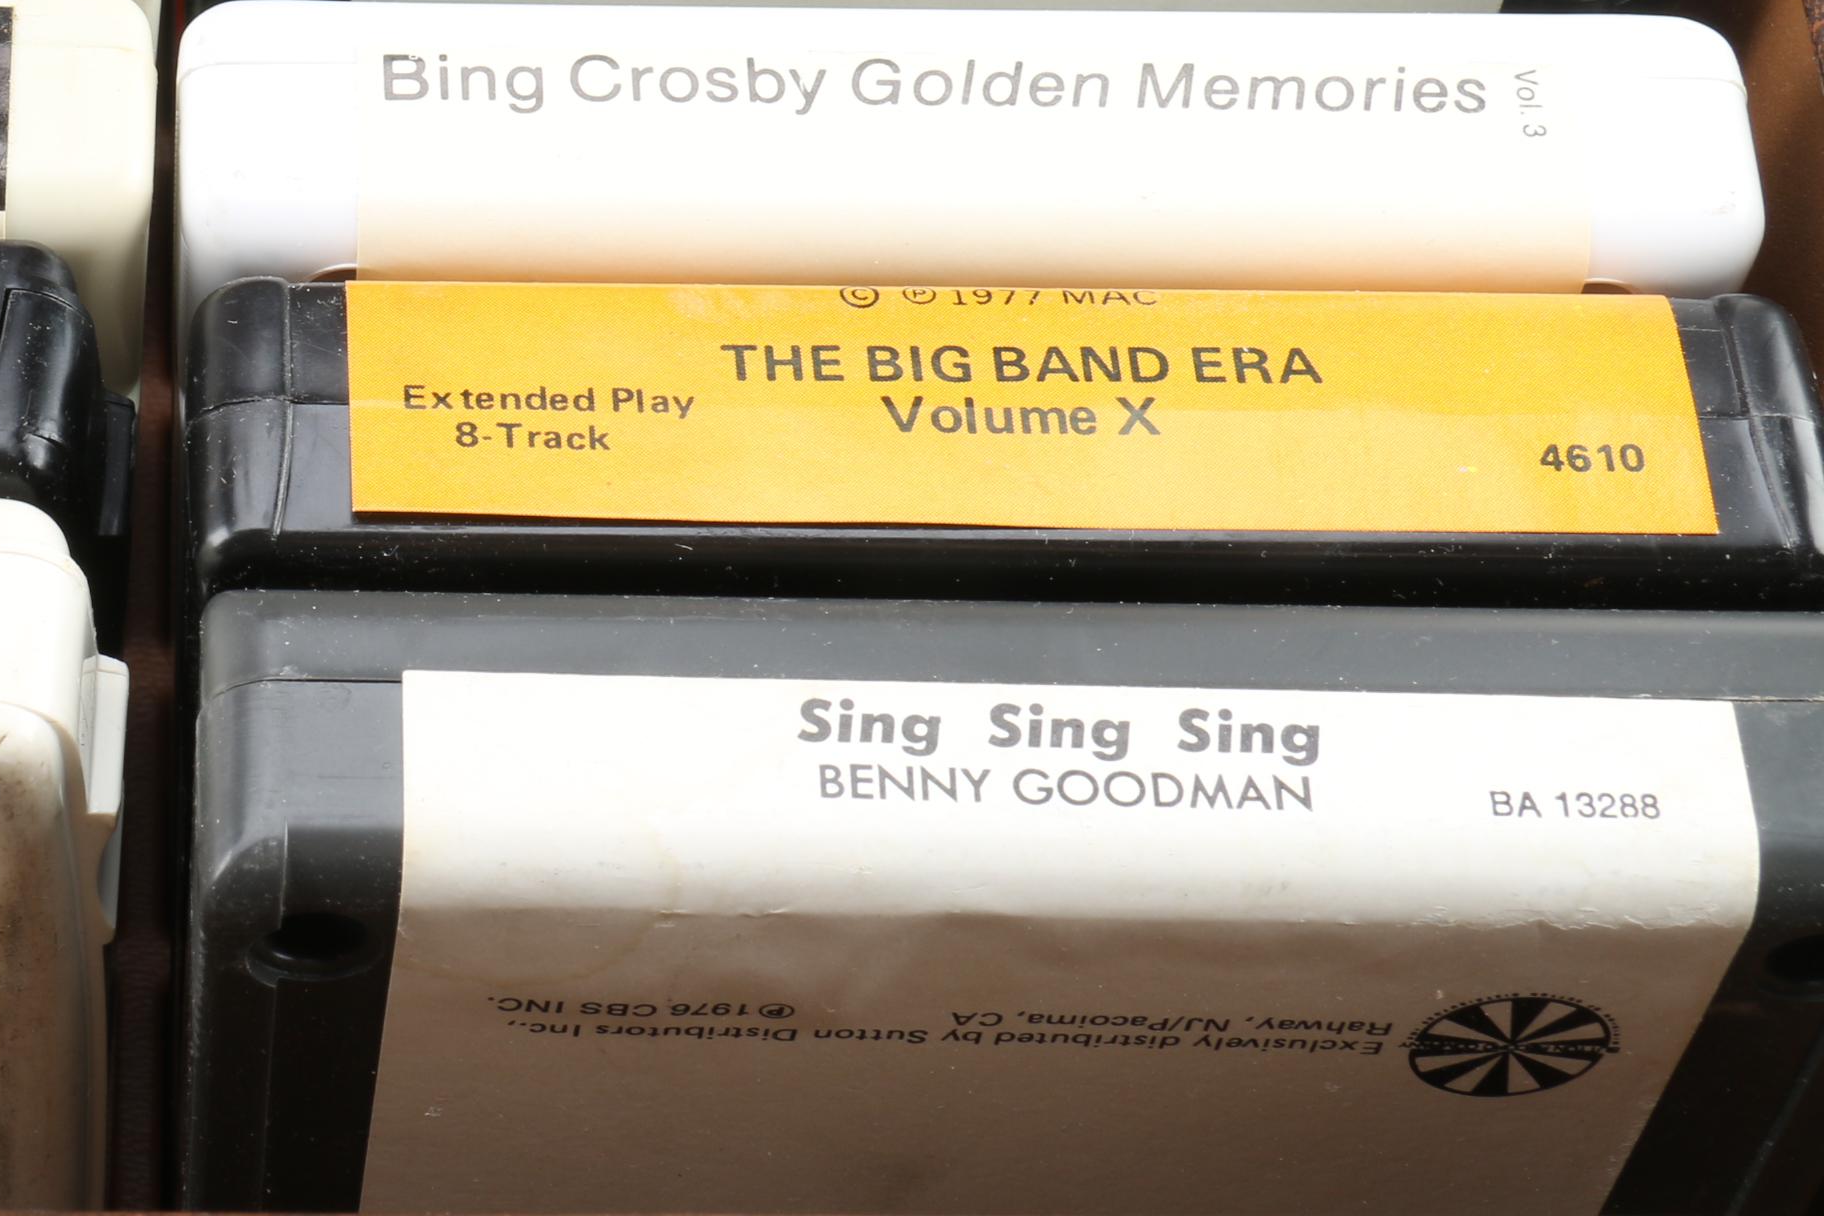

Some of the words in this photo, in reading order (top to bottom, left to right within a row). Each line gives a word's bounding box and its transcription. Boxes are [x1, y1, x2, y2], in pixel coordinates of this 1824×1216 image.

[383, 54, 543, 113] Bing
[570, 55, 826, 115] Crosby
[852, 58, 1109, 107] Golden
[1138, 63, 1485, 113] Memories
[1523, 125, 1547, 137] 3
[953, 290, 1040, 305] 1977
[1063, 291, 1156, 305] MAC
[720, 345, 844, 381] THE
[867, 345, 972, 383] BIG
[992, 346, 1169, 383] BAND
[1191, 347, 1322, 383] ERA
[404, 385, 594, 411] Extended
[612, 388, 694, 419] Play
[880, 396, 1096, 435] Volume
[1116, 397, 1160, 435] X
[456, 422, 610, 450] 8-Track
[1540, 444, 1644, 472] 4610
[798, 698, 941, 756] Sing
[989, 703, 1130, 761] Sing
[1178, 708, 1319, 766] Sing
[819, 764, 990, 802] BENNY
[1013, 769, 1312, 811] GOODMAN
[1490, 791, 1541, 817] BA
[1556, 792, 1660, 819] 13288
[488, 997, 563, 1013] INC.
[580, 1002, 657, 1017] CBS
[952, 1013, 1003, 1026] CA
[1246, 1017, 1392, 1036] Rahway,
[596, 1025, 797, 1041] Distributors
[814, 1029, 928, 1044] Sutton
[941, 1029, 982, 1044] by
[994, 1026, 1180, 1049] distributed
[1193, 1035, 1383, 1055] Exclusively
